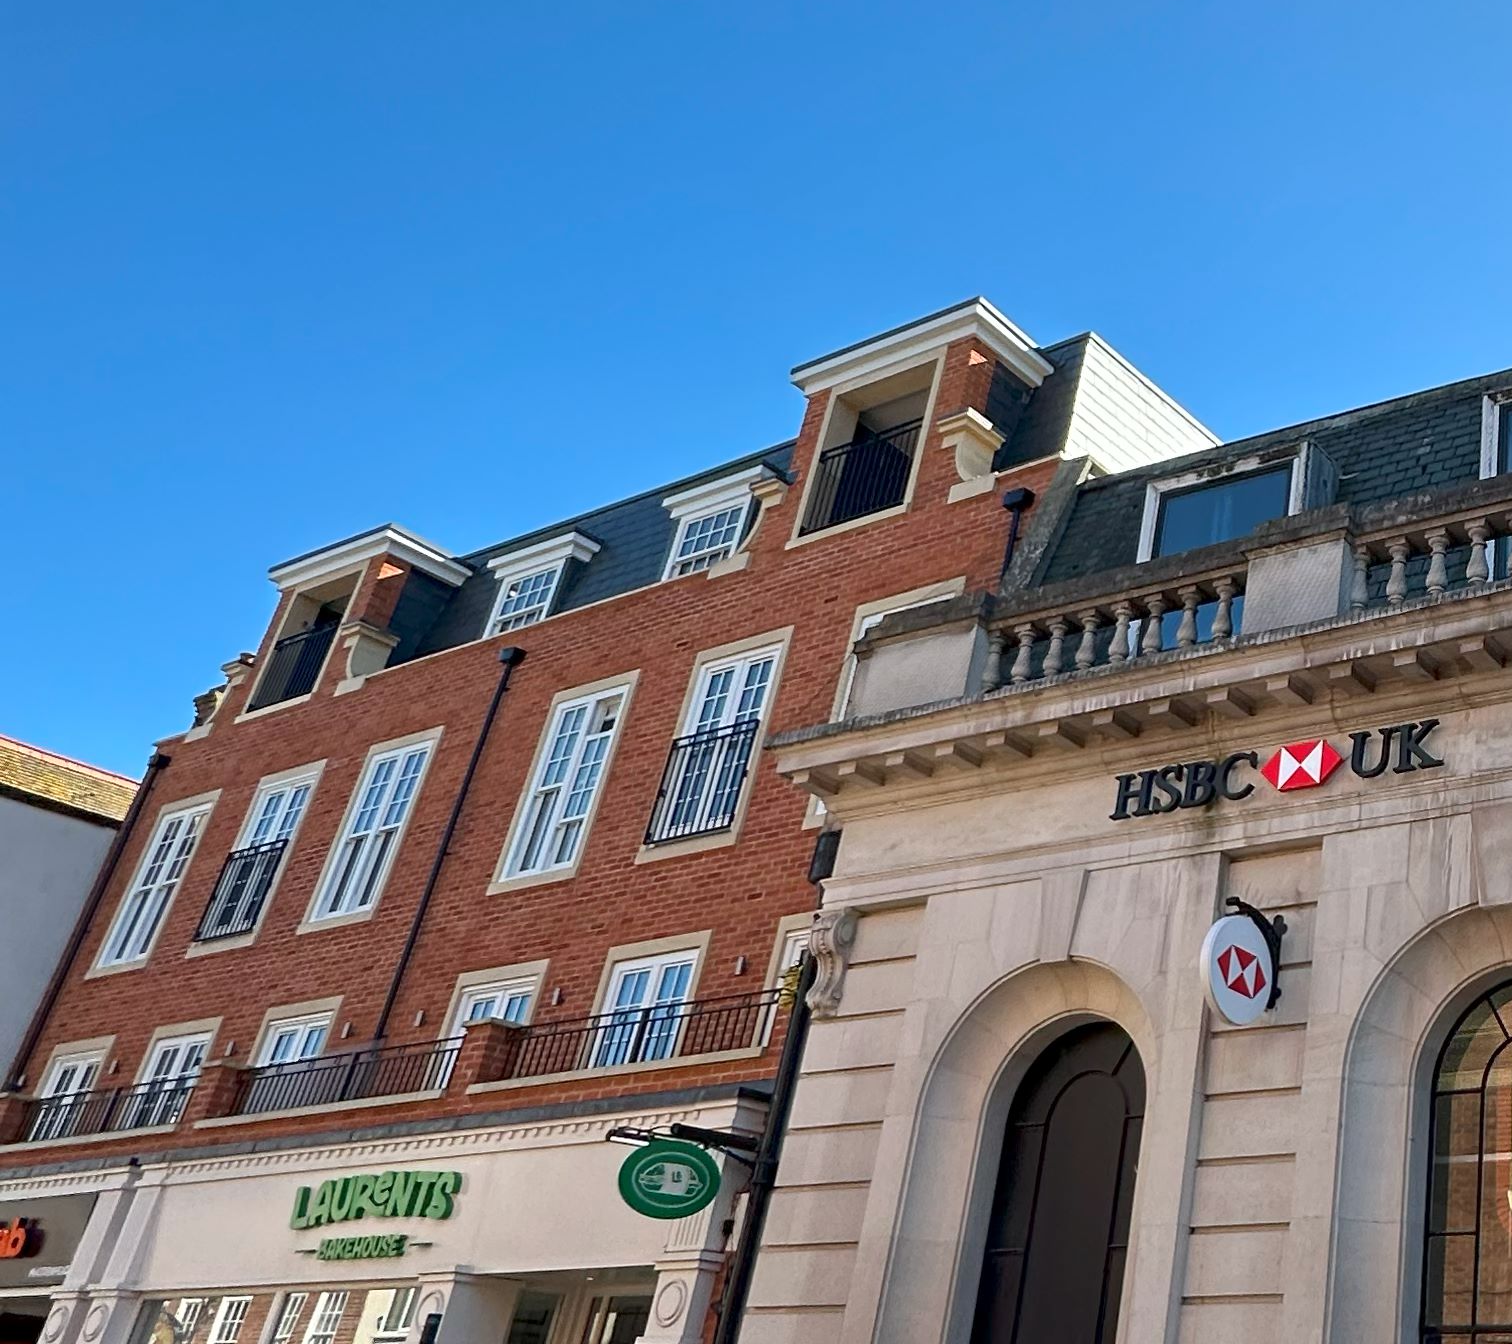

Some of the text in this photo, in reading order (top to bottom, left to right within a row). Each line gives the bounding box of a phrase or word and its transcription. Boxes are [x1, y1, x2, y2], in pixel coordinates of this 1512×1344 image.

[1109, 718, 1445, 821] HSBC UK
[316, 1234, 409, 1261] BAKEHOUSE
